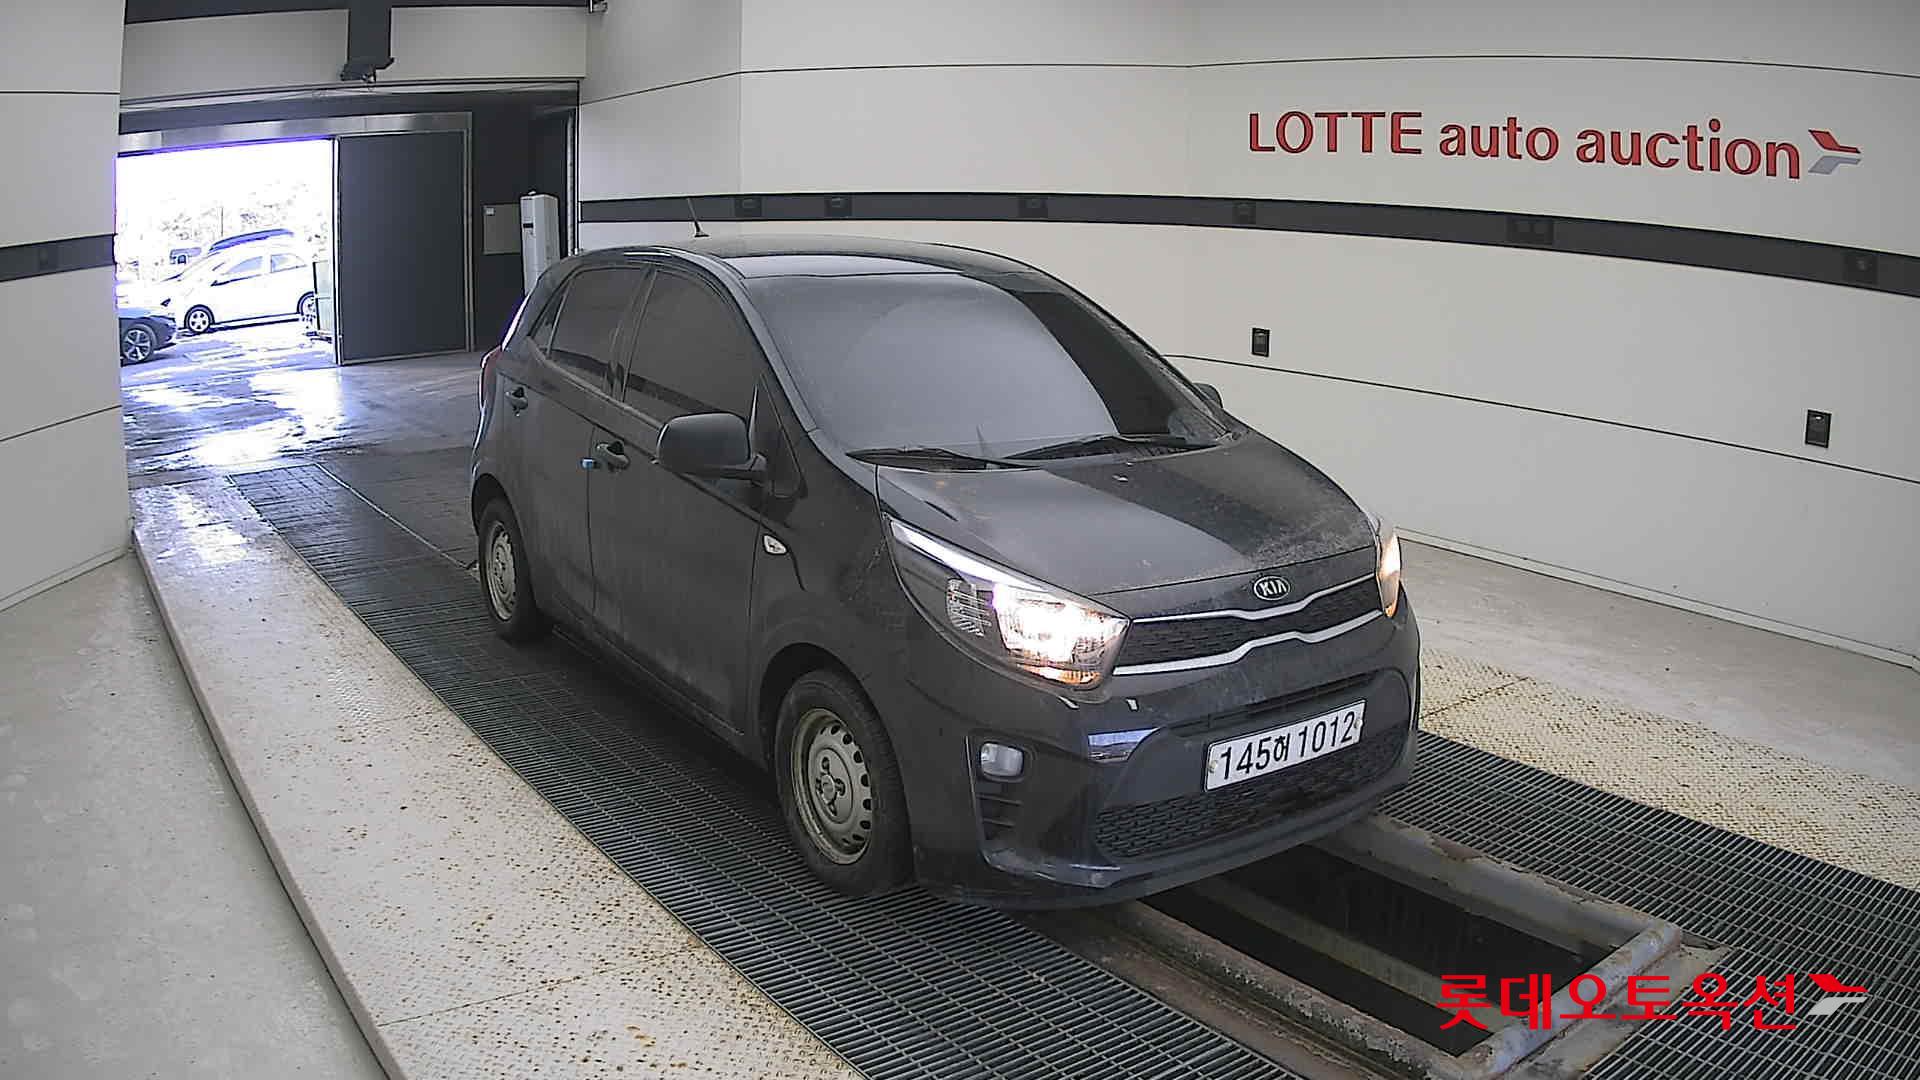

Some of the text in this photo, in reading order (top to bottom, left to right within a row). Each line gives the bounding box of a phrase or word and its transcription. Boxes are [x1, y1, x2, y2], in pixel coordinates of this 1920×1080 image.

[1249, 110, 1801, 179] LOTTE auto auction
[1258, 579, 1287, 597] KIA
[1299, 711, 1355, 757] 1012
